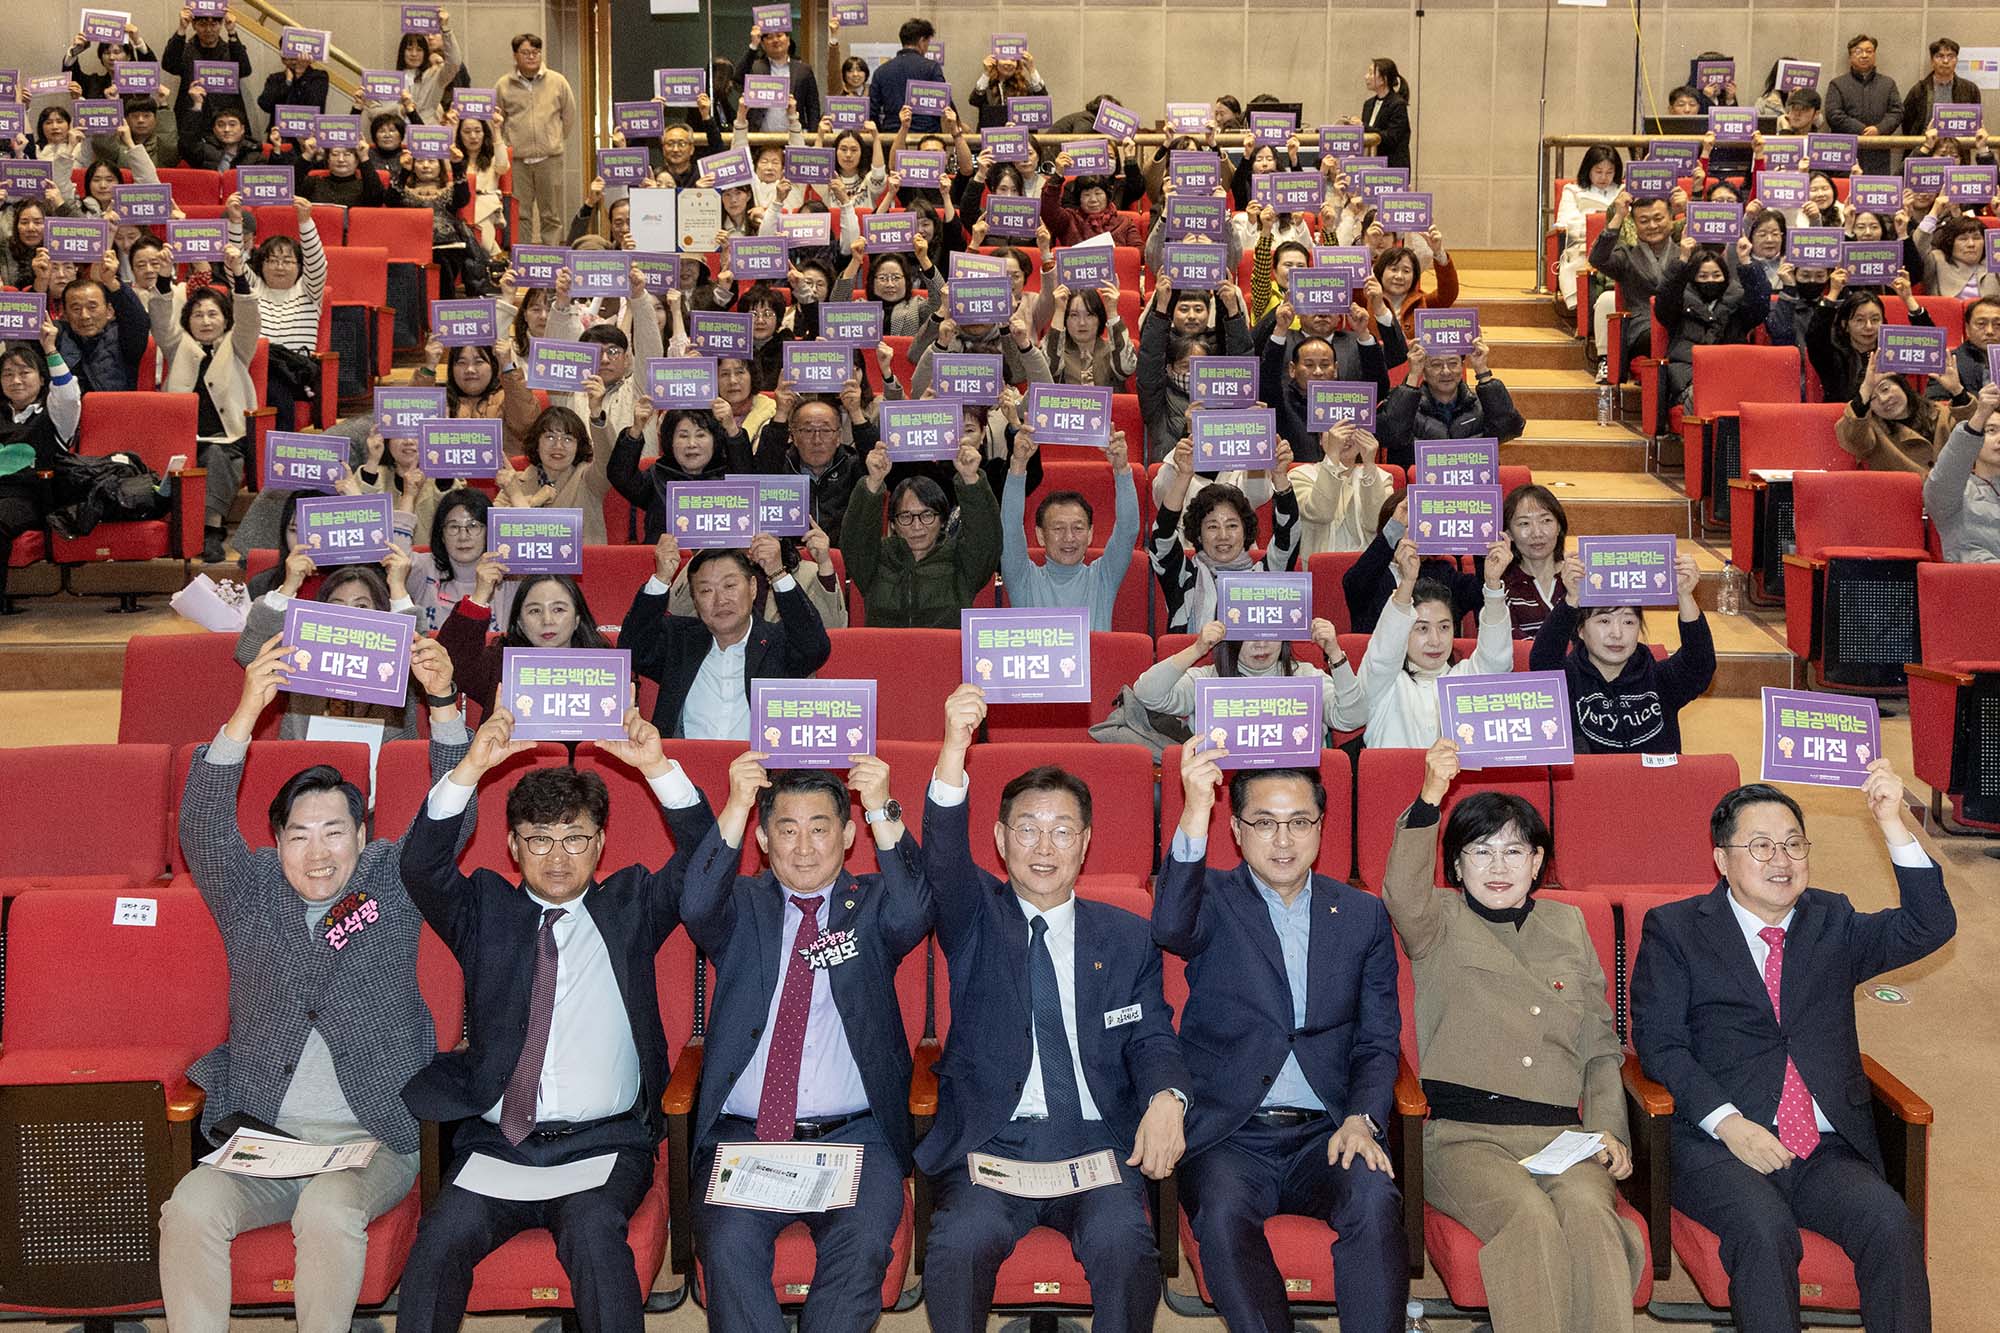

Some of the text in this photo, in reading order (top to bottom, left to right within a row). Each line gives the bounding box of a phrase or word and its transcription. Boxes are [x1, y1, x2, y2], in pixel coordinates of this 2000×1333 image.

[89, 116, 108, 126] 대전
[631, 119, 649, 129] 대전
[1948, 120, 1967, 129] 대전
[1724, 123, 1743, 133] 대전
[329, 131, 347, 140] 대전
[421, 141, 439, 151] 대전
[996, 144, 1014, 153] 대전
[1077, 157, 1095, 167] 대전
[1822, 151, 1841, 161] 대전
[615, 166, 634, 176] 대전
[800, 165, 819, 176] 대전
[910, 168, 929, 178] 대전
[17, 179, 36, 188] 대전
[1186, 175, 1205, 185] 대전
[1642, 180, 1662, 190] 대전
[255, 186, 276, 197] 대전
[1774, 189, 1794, 199] 대전
[1962, 184, 1981, 194] 대전
[1287, 191, 1308, 202] 대전
[1867, 194, 1887, 204] 대전
[132, 204, 154, 215] 대전
[1003, 216, 1023, 227] 대전
[1185, 217, 1207, 229] 대전
[1394, 212, 1415, 222] 대전
[793, 228, 813, 237] 대전
[1705, 222, 1726, 233] 대전
[880, 231, 901, 242] 대전
[64, 239, 88, 251] 대전
[187, 240, 210, 251] 대전
[1804, 247, 1826, 258] 대전
[749, 257, 771, 268] 대전
[1860, 263, 1884, 274] 대전
[530, 266, 552, 278] 대전
[1075, 267, 1097, 279] 대전
[1183, 266, 1207, 279] 대전
[588, 274, 612, 286] 대전
[1310, 291, 1333, 303] 대전
[969, 300, 993, 312] 대전
[453, 323, 477, 335] 대전
[840, 325, 863, 337] 대전
[709, 335, 732, 348] 대전
[1436, 331, 1460, 344] 대전
[1900, 349, 1925, 362] 대전
[550, 364, 577, 379] 대전
[806, 366, 832, 379] 대전
[670, 383, 696, 396] 대전
[955, 380, 980, 393] 대전
[1212, 382, 1238, 395] 대전
[1040, 396, 1101, 410] 돌봄공백없는
[891, 413, 953, 427] 돌봄공백없는
[1330, 407, 1355, 420] 대전
[1054, 413, 1084, 429] 대전
[1204, 423, 1266, 436] 돌봄공백없는
[429, 433, 493, 444] 돌봄공백없는
[907, 429, 938, 446] 대전
[276, 446, 336, 461] 돌봄공백없는
[1220, 440, 1250, 456] 대전
[445, 449, 476, 464] 대전
[1427, 453, 1490, 467] 돌봄공백없는
[291, 463, 321, 479] 대전
[1443, 469, 1474, 485] 대전
[679, 496, 748, 509] 돌봄공백없는
[1422, 500, 1491, 514] 돌봄공백없는
[310, 511, 383, 526] 돌봄공백없는
[696, 514, 730, 531] 대전
[500, 524, 571, 536] 돌봄공백없는
[1439, 520, 1473, 537] 대전
[328, 528, 364, 547] 대전
[518, 542, 552, 559] 대전
[1592, 552, 1664, 566] 돌봄공백없는
[1611, 571, 1646, 589] 대전
[1230, 588, 1299, 600] 돌봄공백없는
[1248, 606, 1282, 624] 대전
[300, 623, 396, 652] 돌봄공백없는
[979, 630, 1073, 648] 돌봄공백없는
[320, 652, 368, 679] 대전
[1003, 655, 1050, 679] 대전
[520, 668, 615, 686] 돌봄공백없는
[544, 693, 590, 716] 대전
[768, 701, 861, 718] 돌봄공백없는
[1214, 698, 1308, 717] 돌봄공백없는
[1457, 692, 1559, 714] 돌봄공백없는
[1781, 709, 1867, 733] 돌봄공백없는
[791, 725, 836, 747] 대전
[1237, 724, 1282, 747] 대전
[1484, 717, 1532, 742] 대전
[1804, 737, 1847, 762] 대전
[325, 899, 379, 951] 전석광
[809, 930, 853, 953] 서구청장
[809, 940, 859, 970] 서철모
